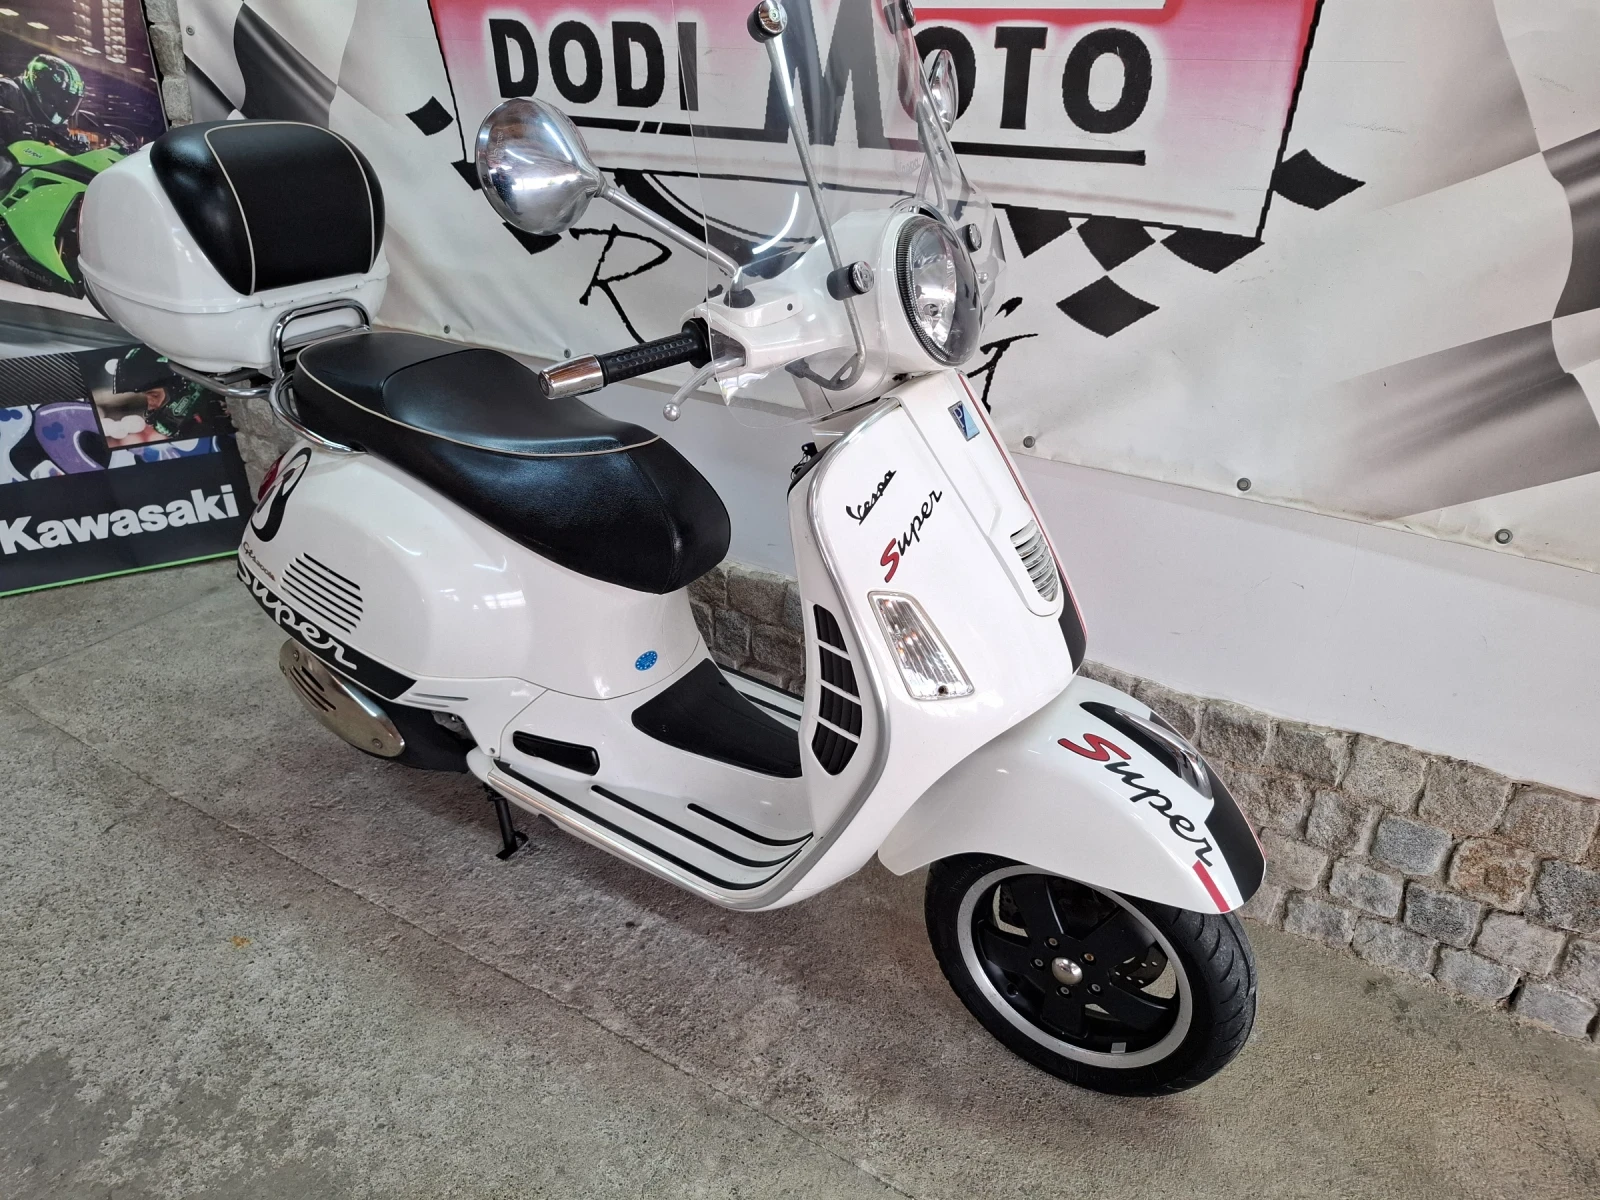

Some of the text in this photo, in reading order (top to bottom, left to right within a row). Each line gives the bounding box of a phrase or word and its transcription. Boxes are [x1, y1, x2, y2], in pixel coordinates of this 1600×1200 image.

[488, 0, 1153, 149] DODI MOTO
[0, 484, 240, 555] Kawasaki
[845, 469, 897, 526] Vespa
[880, 489, 943, 584] Super
[1057, 732, 1214, 868] Super
